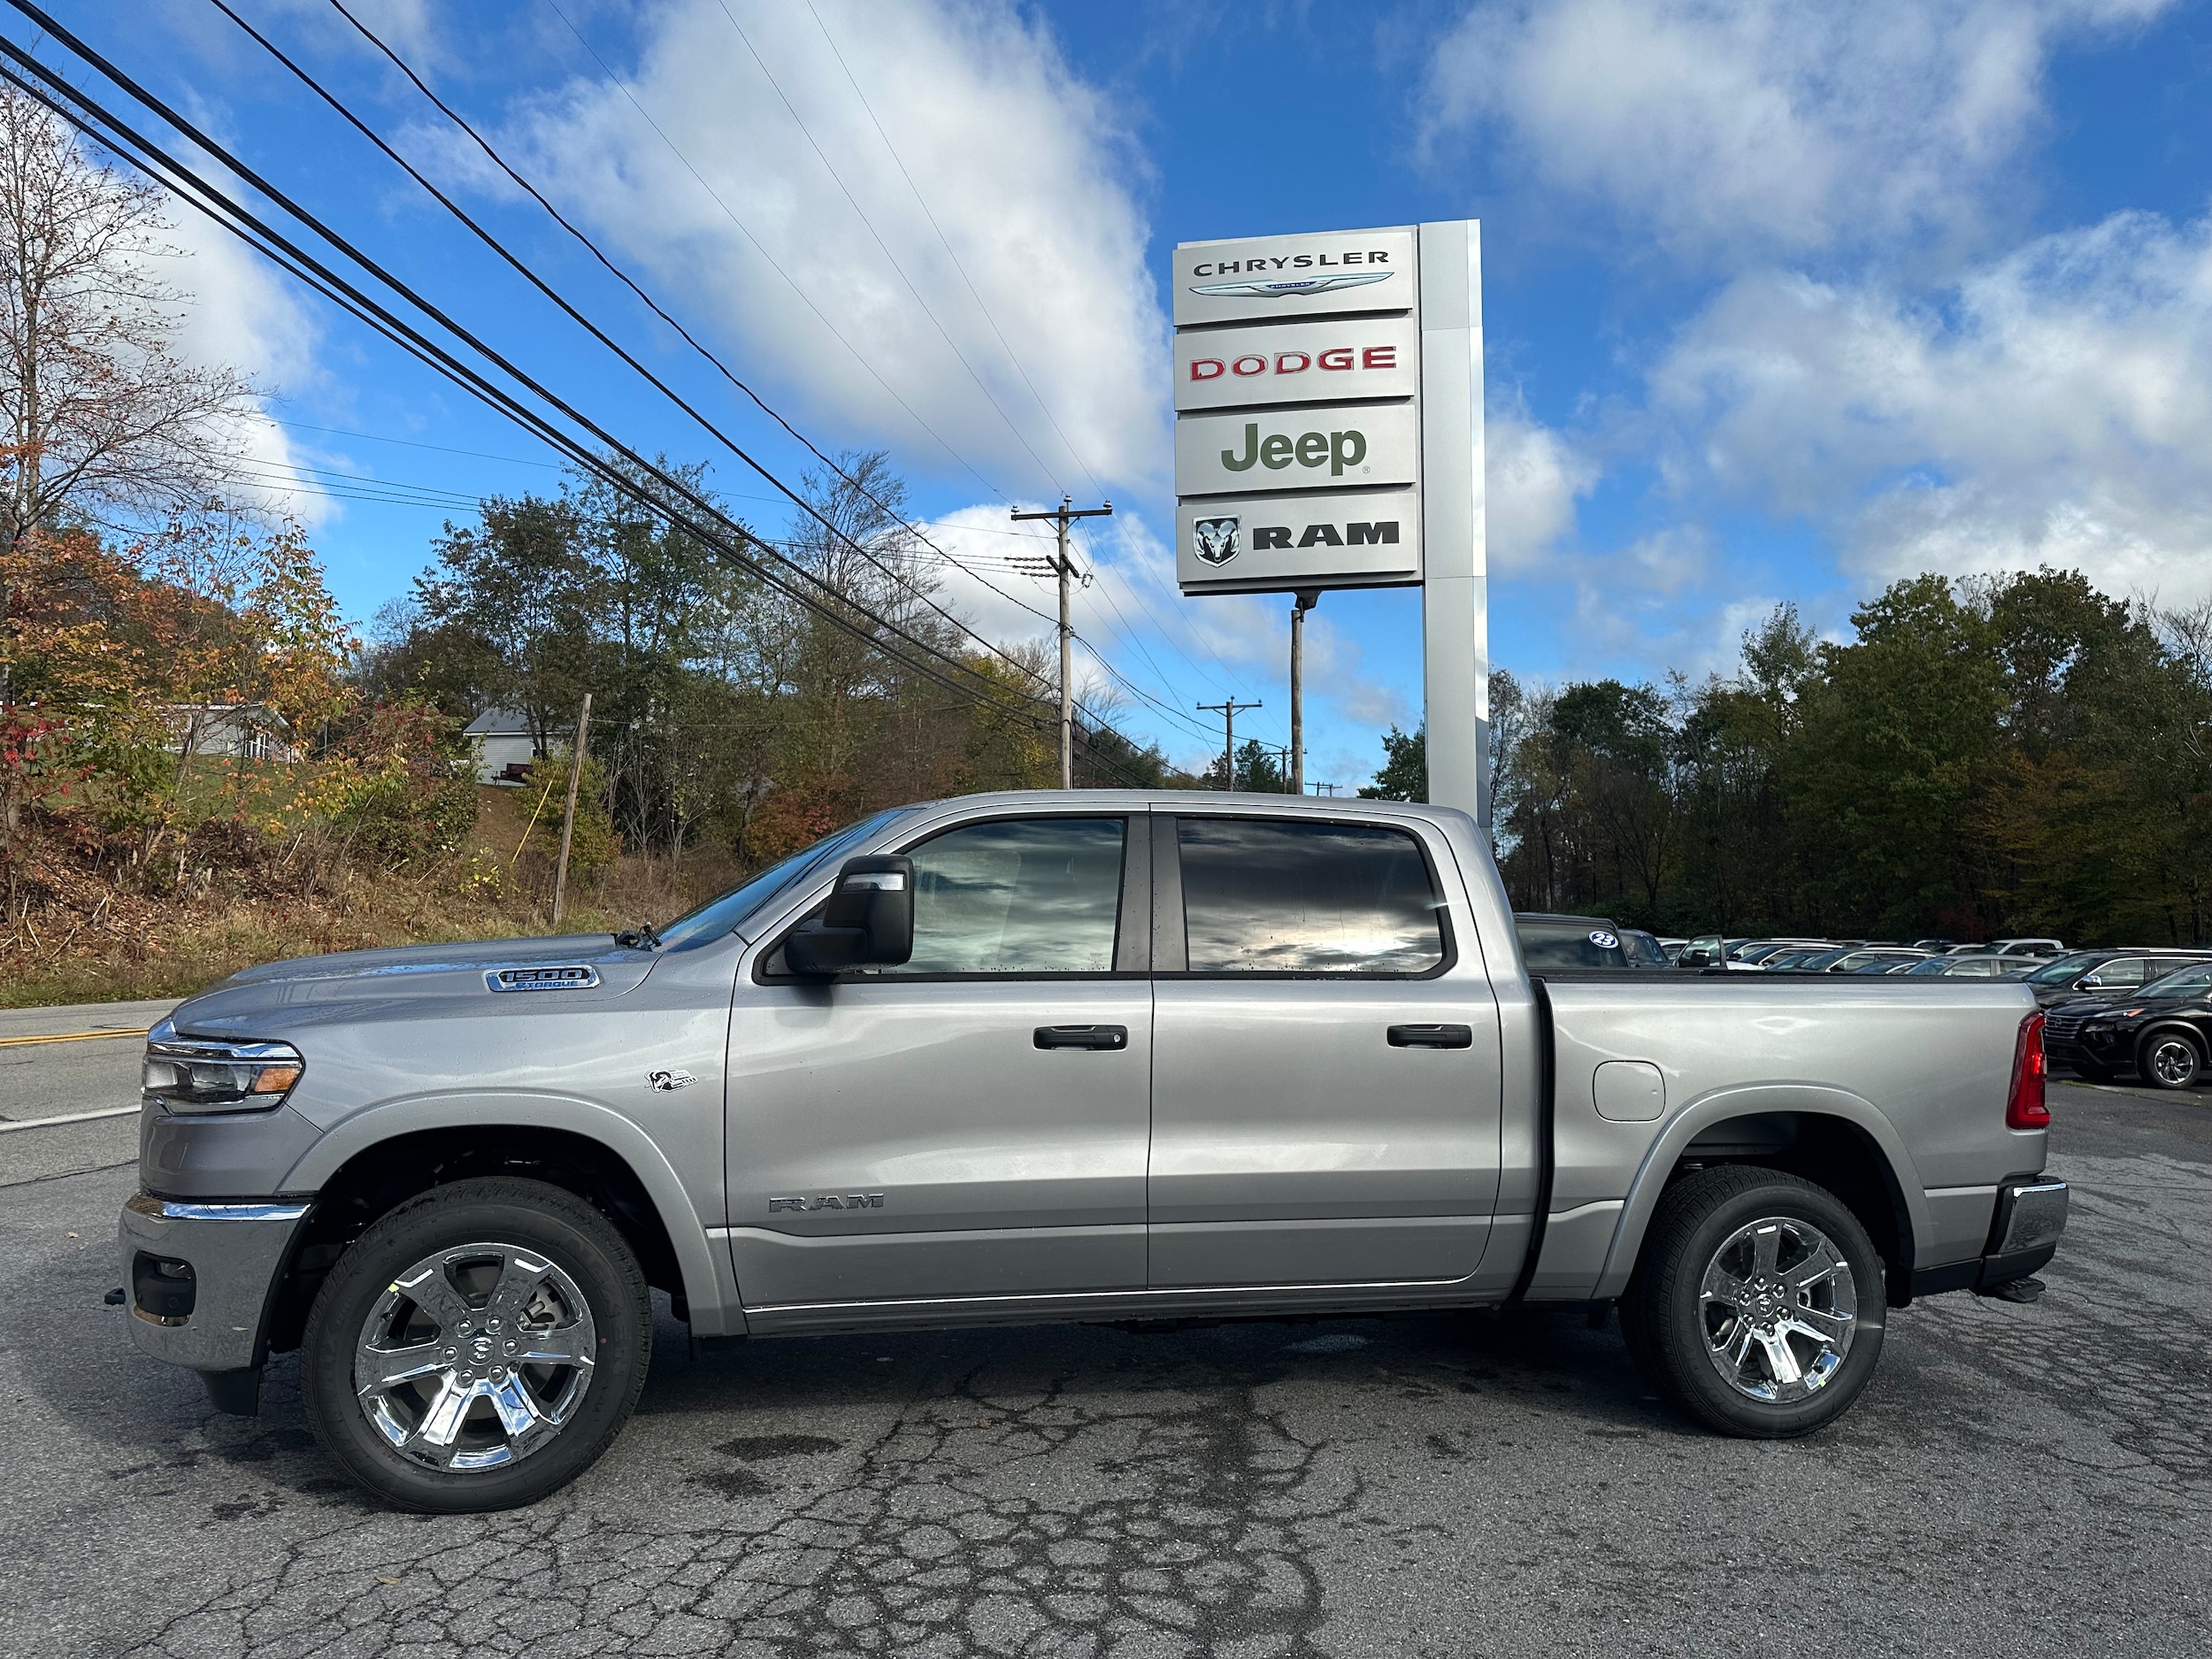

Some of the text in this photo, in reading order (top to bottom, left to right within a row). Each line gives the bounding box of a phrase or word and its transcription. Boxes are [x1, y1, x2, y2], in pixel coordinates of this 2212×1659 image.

[1193, 250, 1389, 277] CHRYSLER
[1190, 346, 1397, 382] DODGE
[1221, 423, 1367, 477] Jeep
[1253, 521, 1400, 550] RAM
[1593, 933, 1614, 945] 23
[501, 970, 583, 982] 1500
[768, 1193, 885, 1213] RAM
